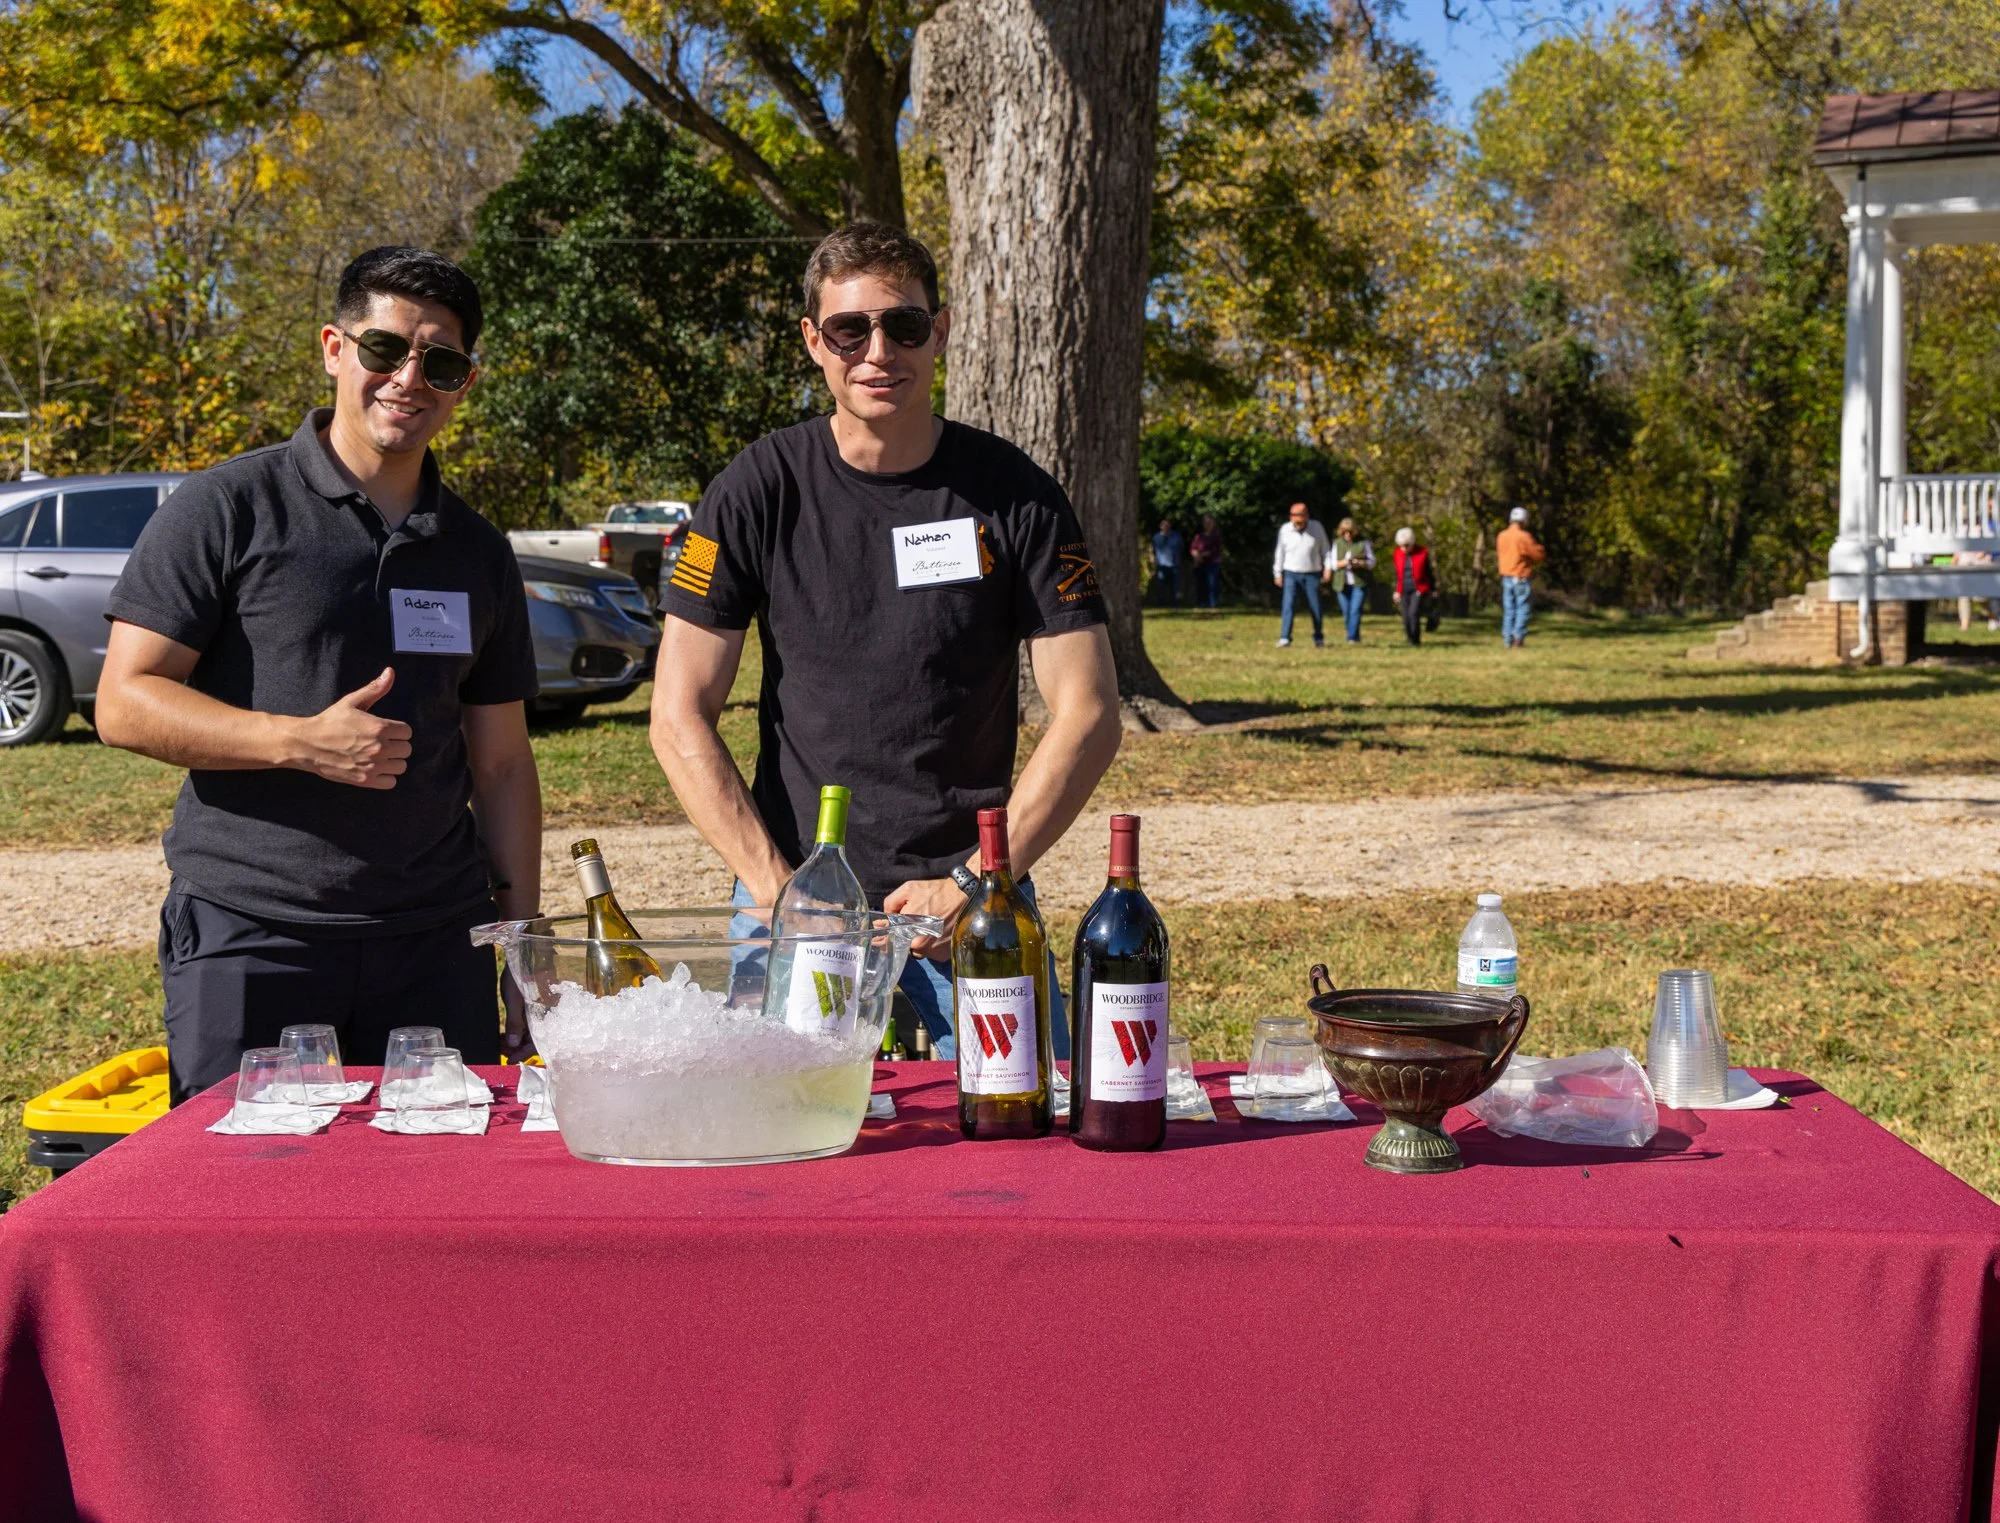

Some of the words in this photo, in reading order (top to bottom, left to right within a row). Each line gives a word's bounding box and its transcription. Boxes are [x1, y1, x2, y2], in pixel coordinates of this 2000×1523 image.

[904, 533, 951, 547] Nathan
[404, 597, 446, 610] Adam
[962, 986, 1027, 998] WOODBRIDGE
[1102, 992, 1165, 1004] WOODBRIDGE
